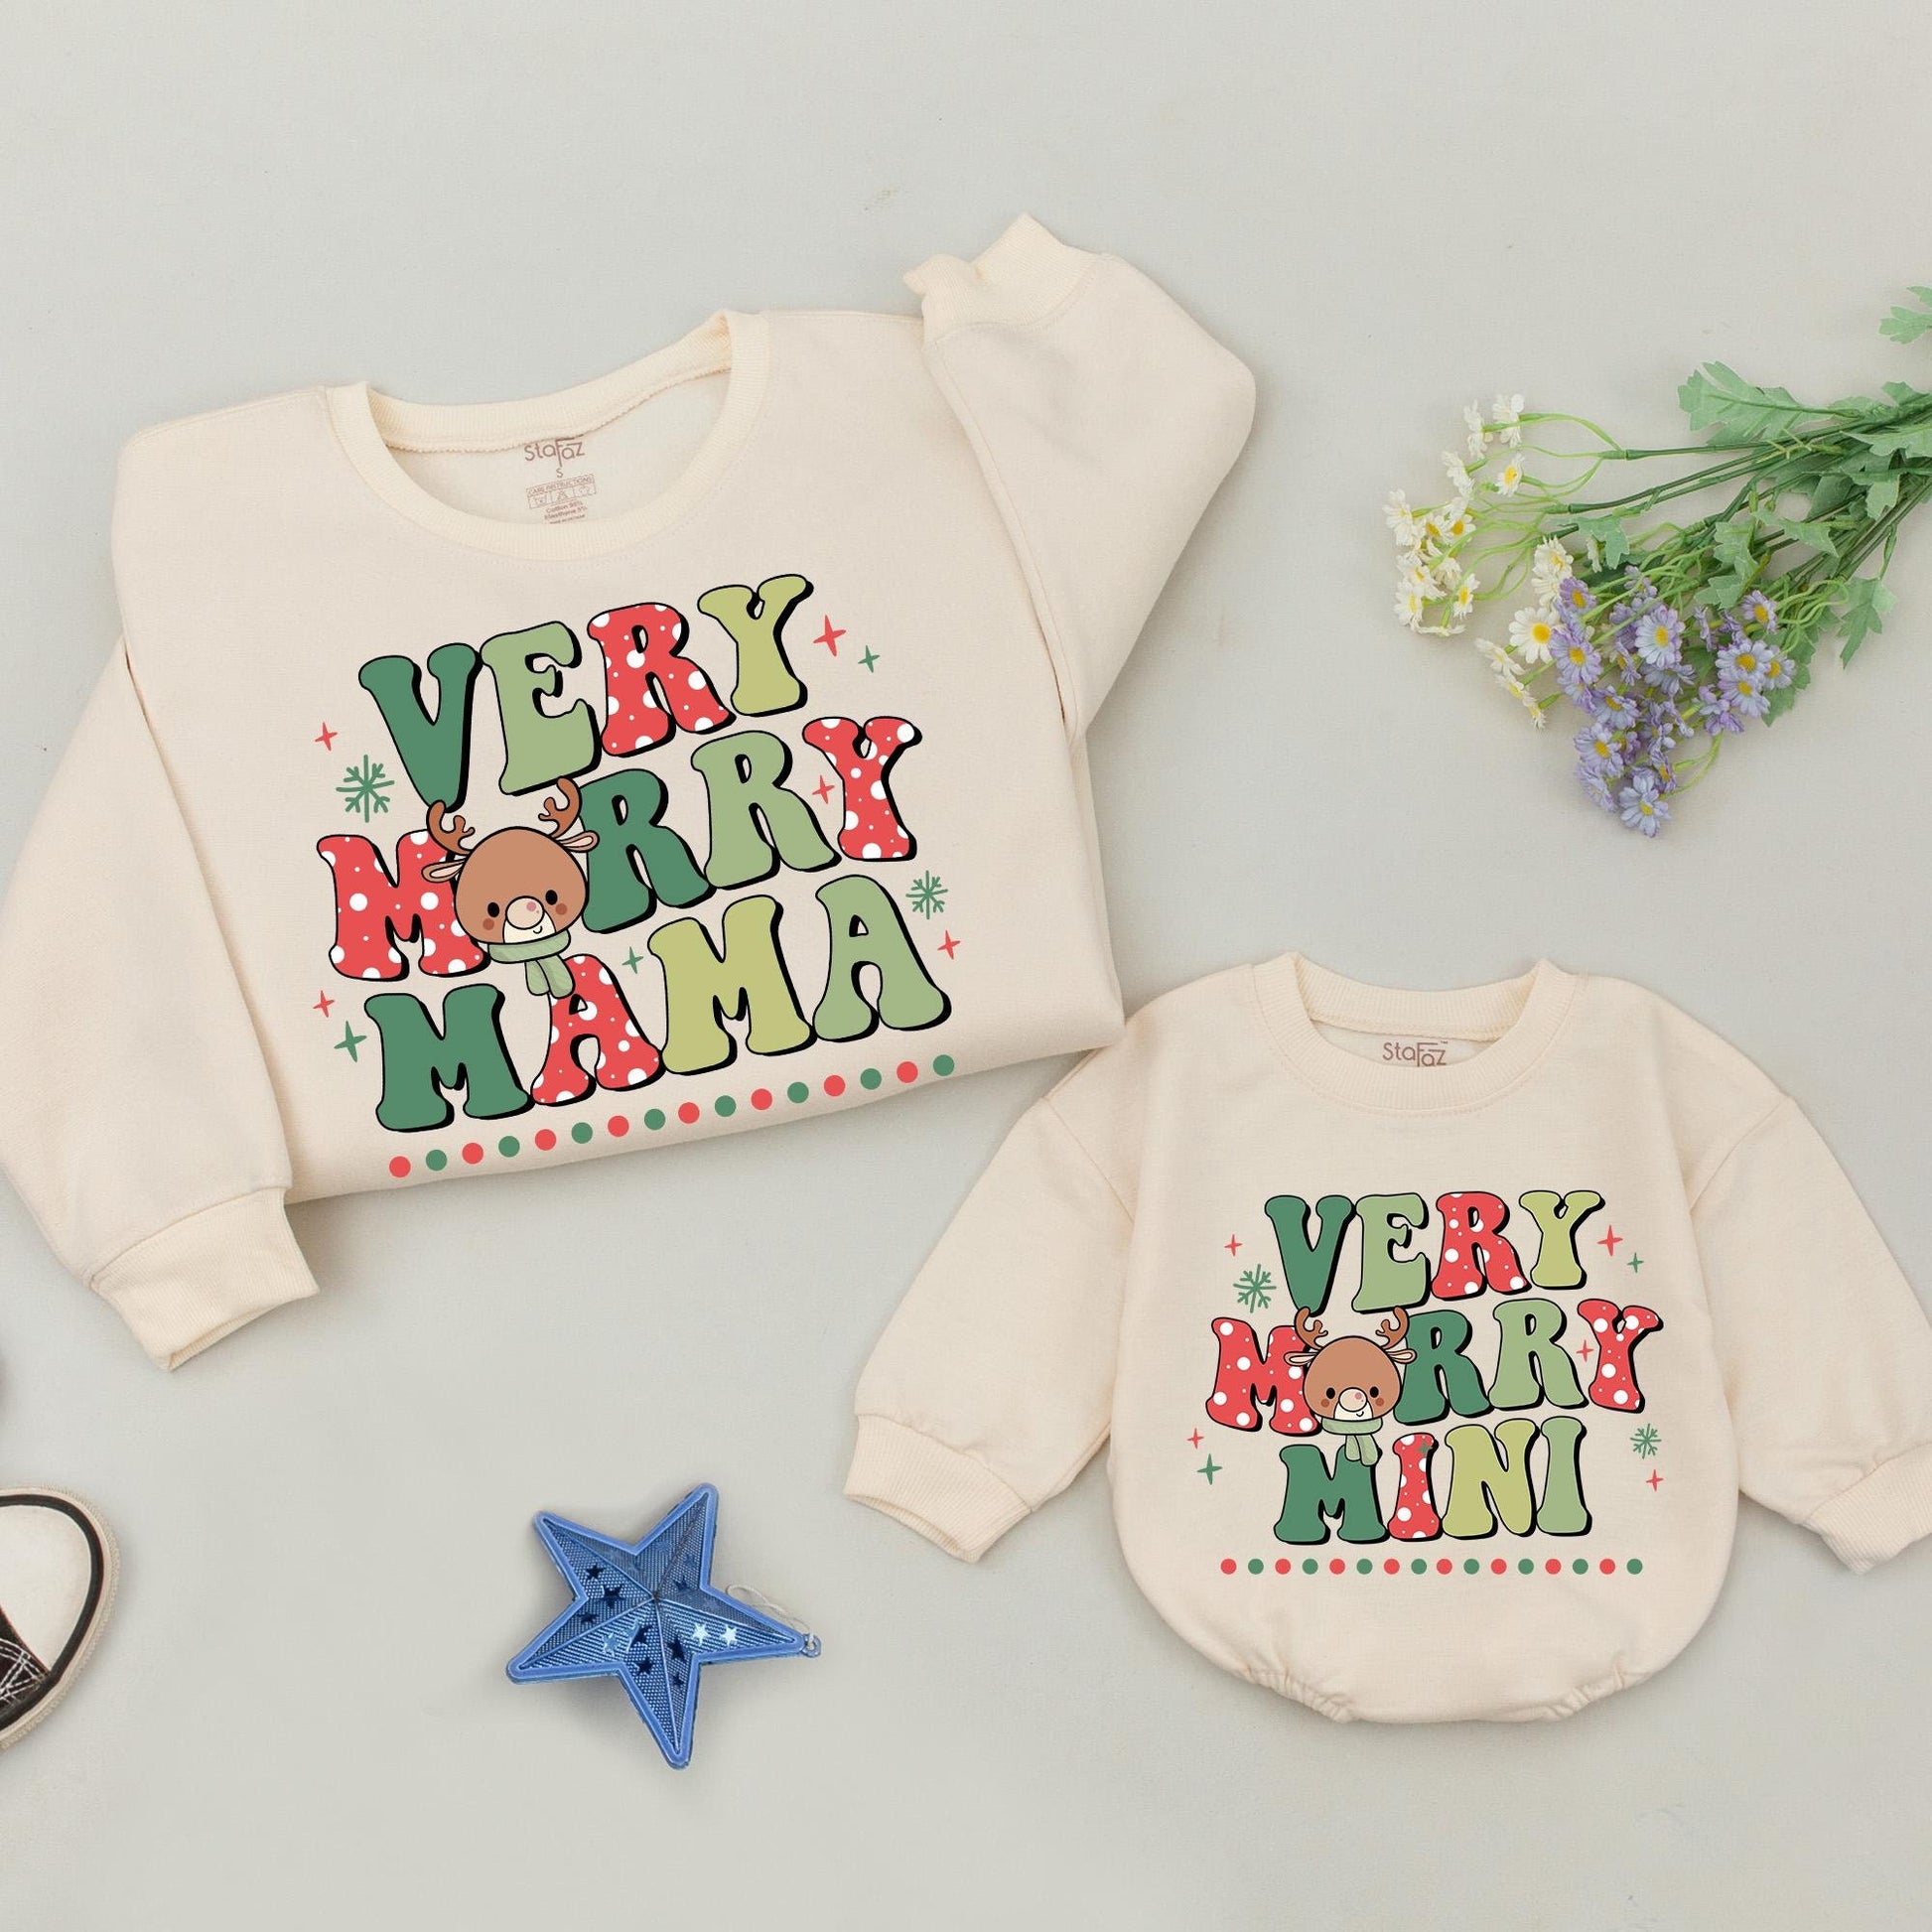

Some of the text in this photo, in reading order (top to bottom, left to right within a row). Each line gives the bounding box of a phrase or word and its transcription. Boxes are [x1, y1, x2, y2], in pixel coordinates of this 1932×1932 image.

[556, 468, 563, 478] S
[358, 574, 814, 813] VERY
[317, 716, 923, 982] MRRY
[363, 875, 952, 1133] MAMA
[1264, 1189, 1606, 1317] VERY
[1205, 1298, 1665, 1437] MRRY
[1273, 1416, 1592, 1545] MINI
